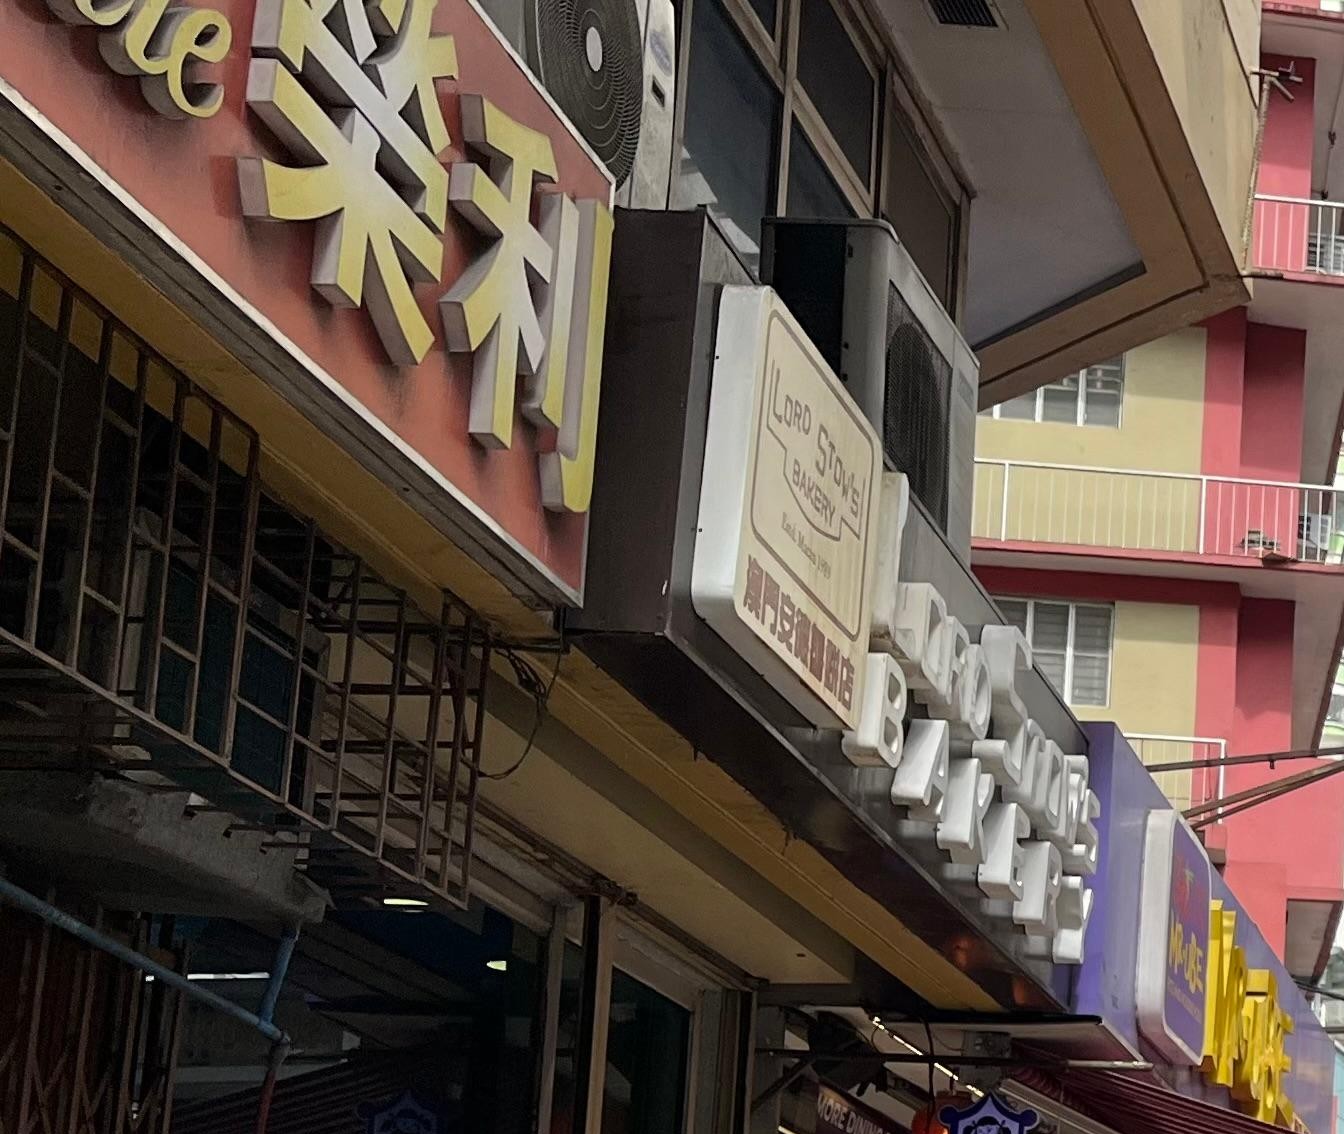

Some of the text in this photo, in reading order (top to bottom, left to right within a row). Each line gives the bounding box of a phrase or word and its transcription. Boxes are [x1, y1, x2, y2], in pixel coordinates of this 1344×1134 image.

[773, 367, 811, 436] LORD
[792, 458, 836, 528] BAKERY
[842, 652, 1093, 964] BAKERY
[818, 1093, 848, 1130] MORE
